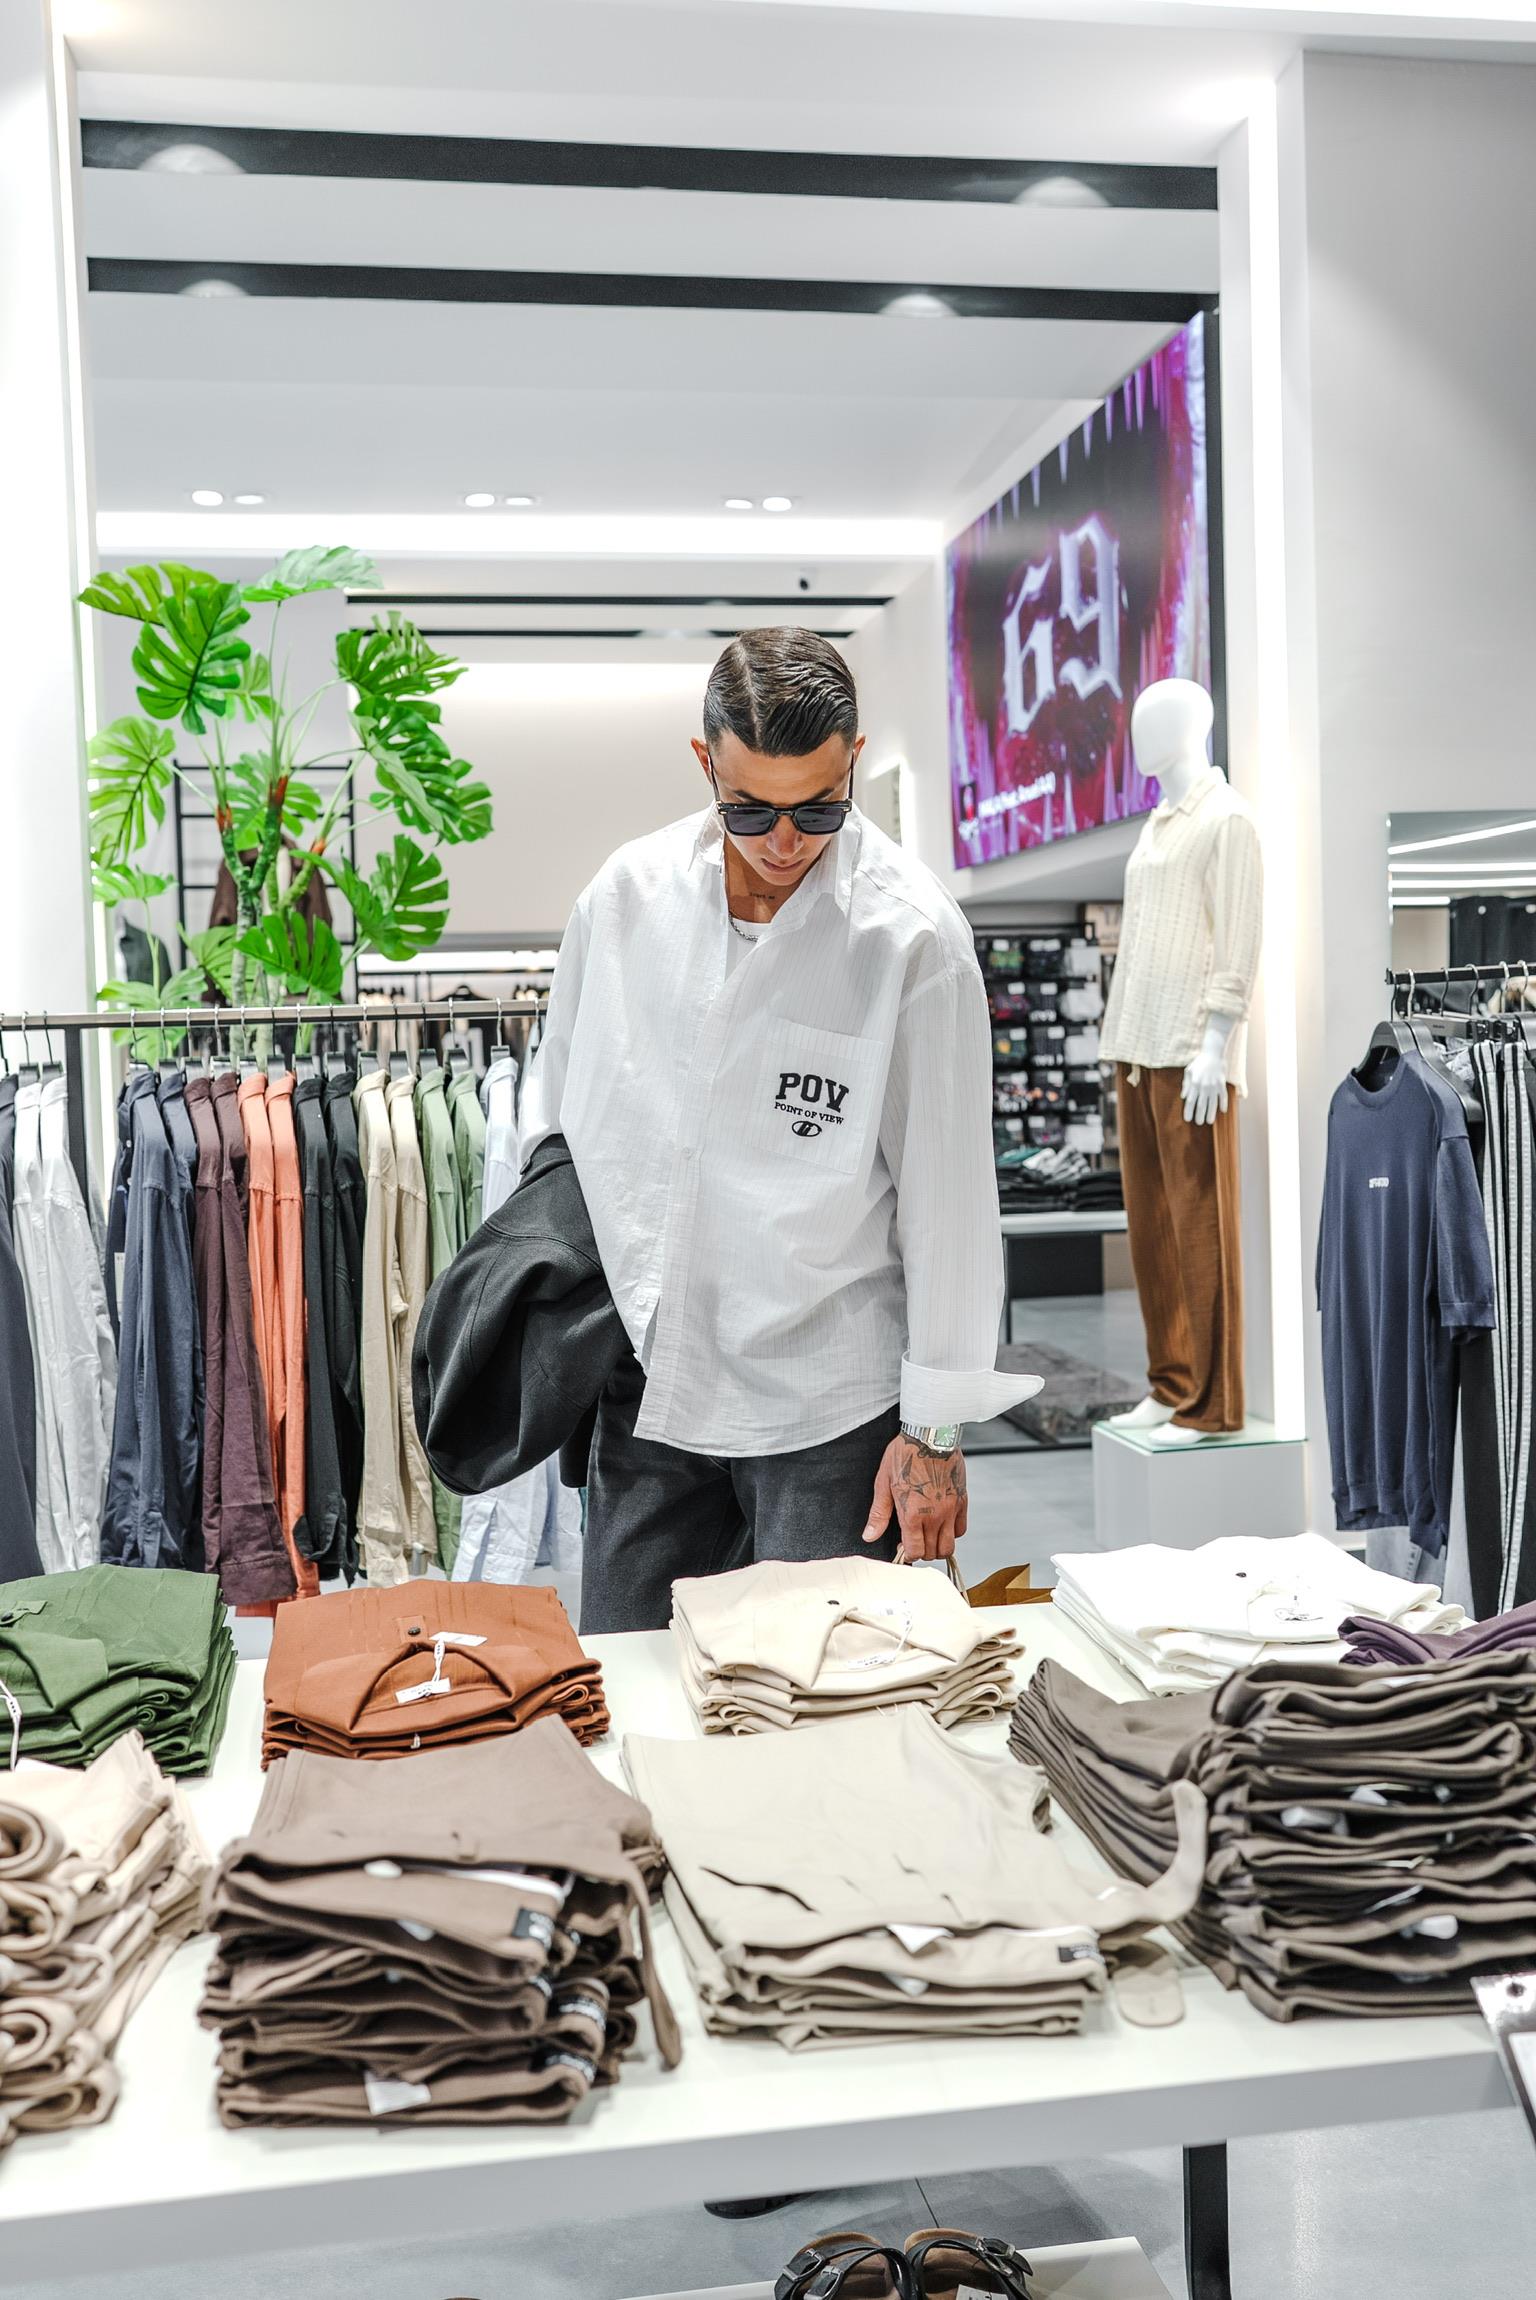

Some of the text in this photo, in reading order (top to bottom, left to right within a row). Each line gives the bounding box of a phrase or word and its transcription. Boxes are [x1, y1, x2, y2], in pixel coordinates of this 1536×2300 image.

[1003, 516, 1123, 736] 69
[774, 1101, 844, 1124] POINT OF VIEW
[775, 1073, 849, 1113] POV
